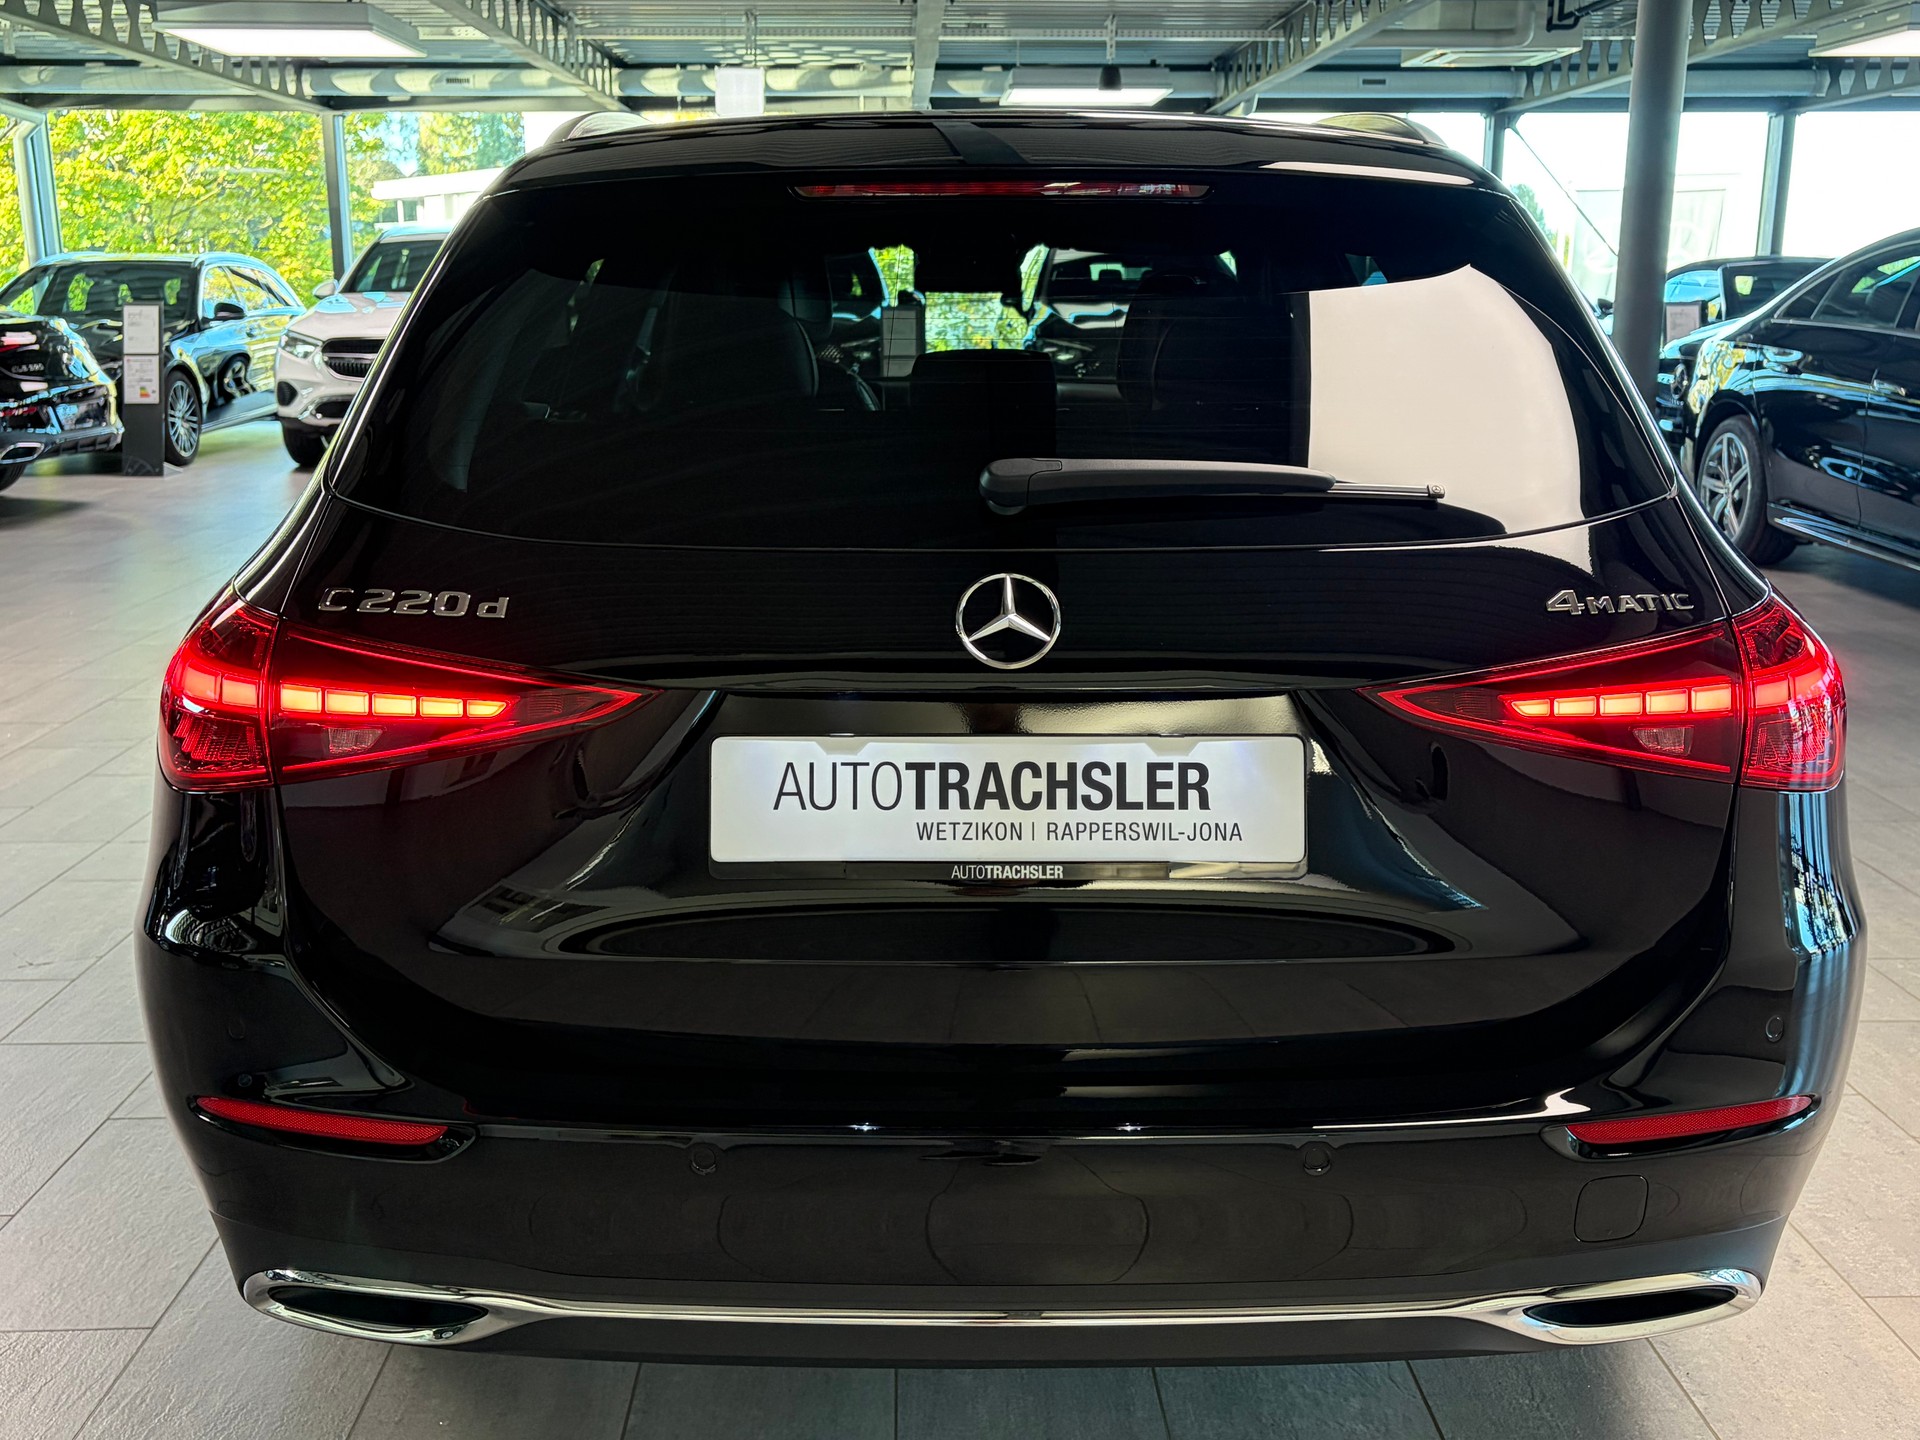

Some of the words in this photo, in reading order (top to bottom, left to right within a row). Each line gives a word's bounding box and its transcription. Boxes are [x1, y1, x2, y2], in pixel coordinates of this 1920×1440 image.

[318, 587, 354, 611] C
[356, 588, 471, 617] 220
[476, 596, 510, 619] d
[1546, 589, 1695, 615] 4MATIC
[773, 760, 1211, 811] AUTOTRACHSLER
[916, 821, 1023, 842] WETZIKON
[1047, 821, 1243, 843] RAPPERSWIL-JONA
[951, 864, 1064, 879] AUTOTRACHSLER
